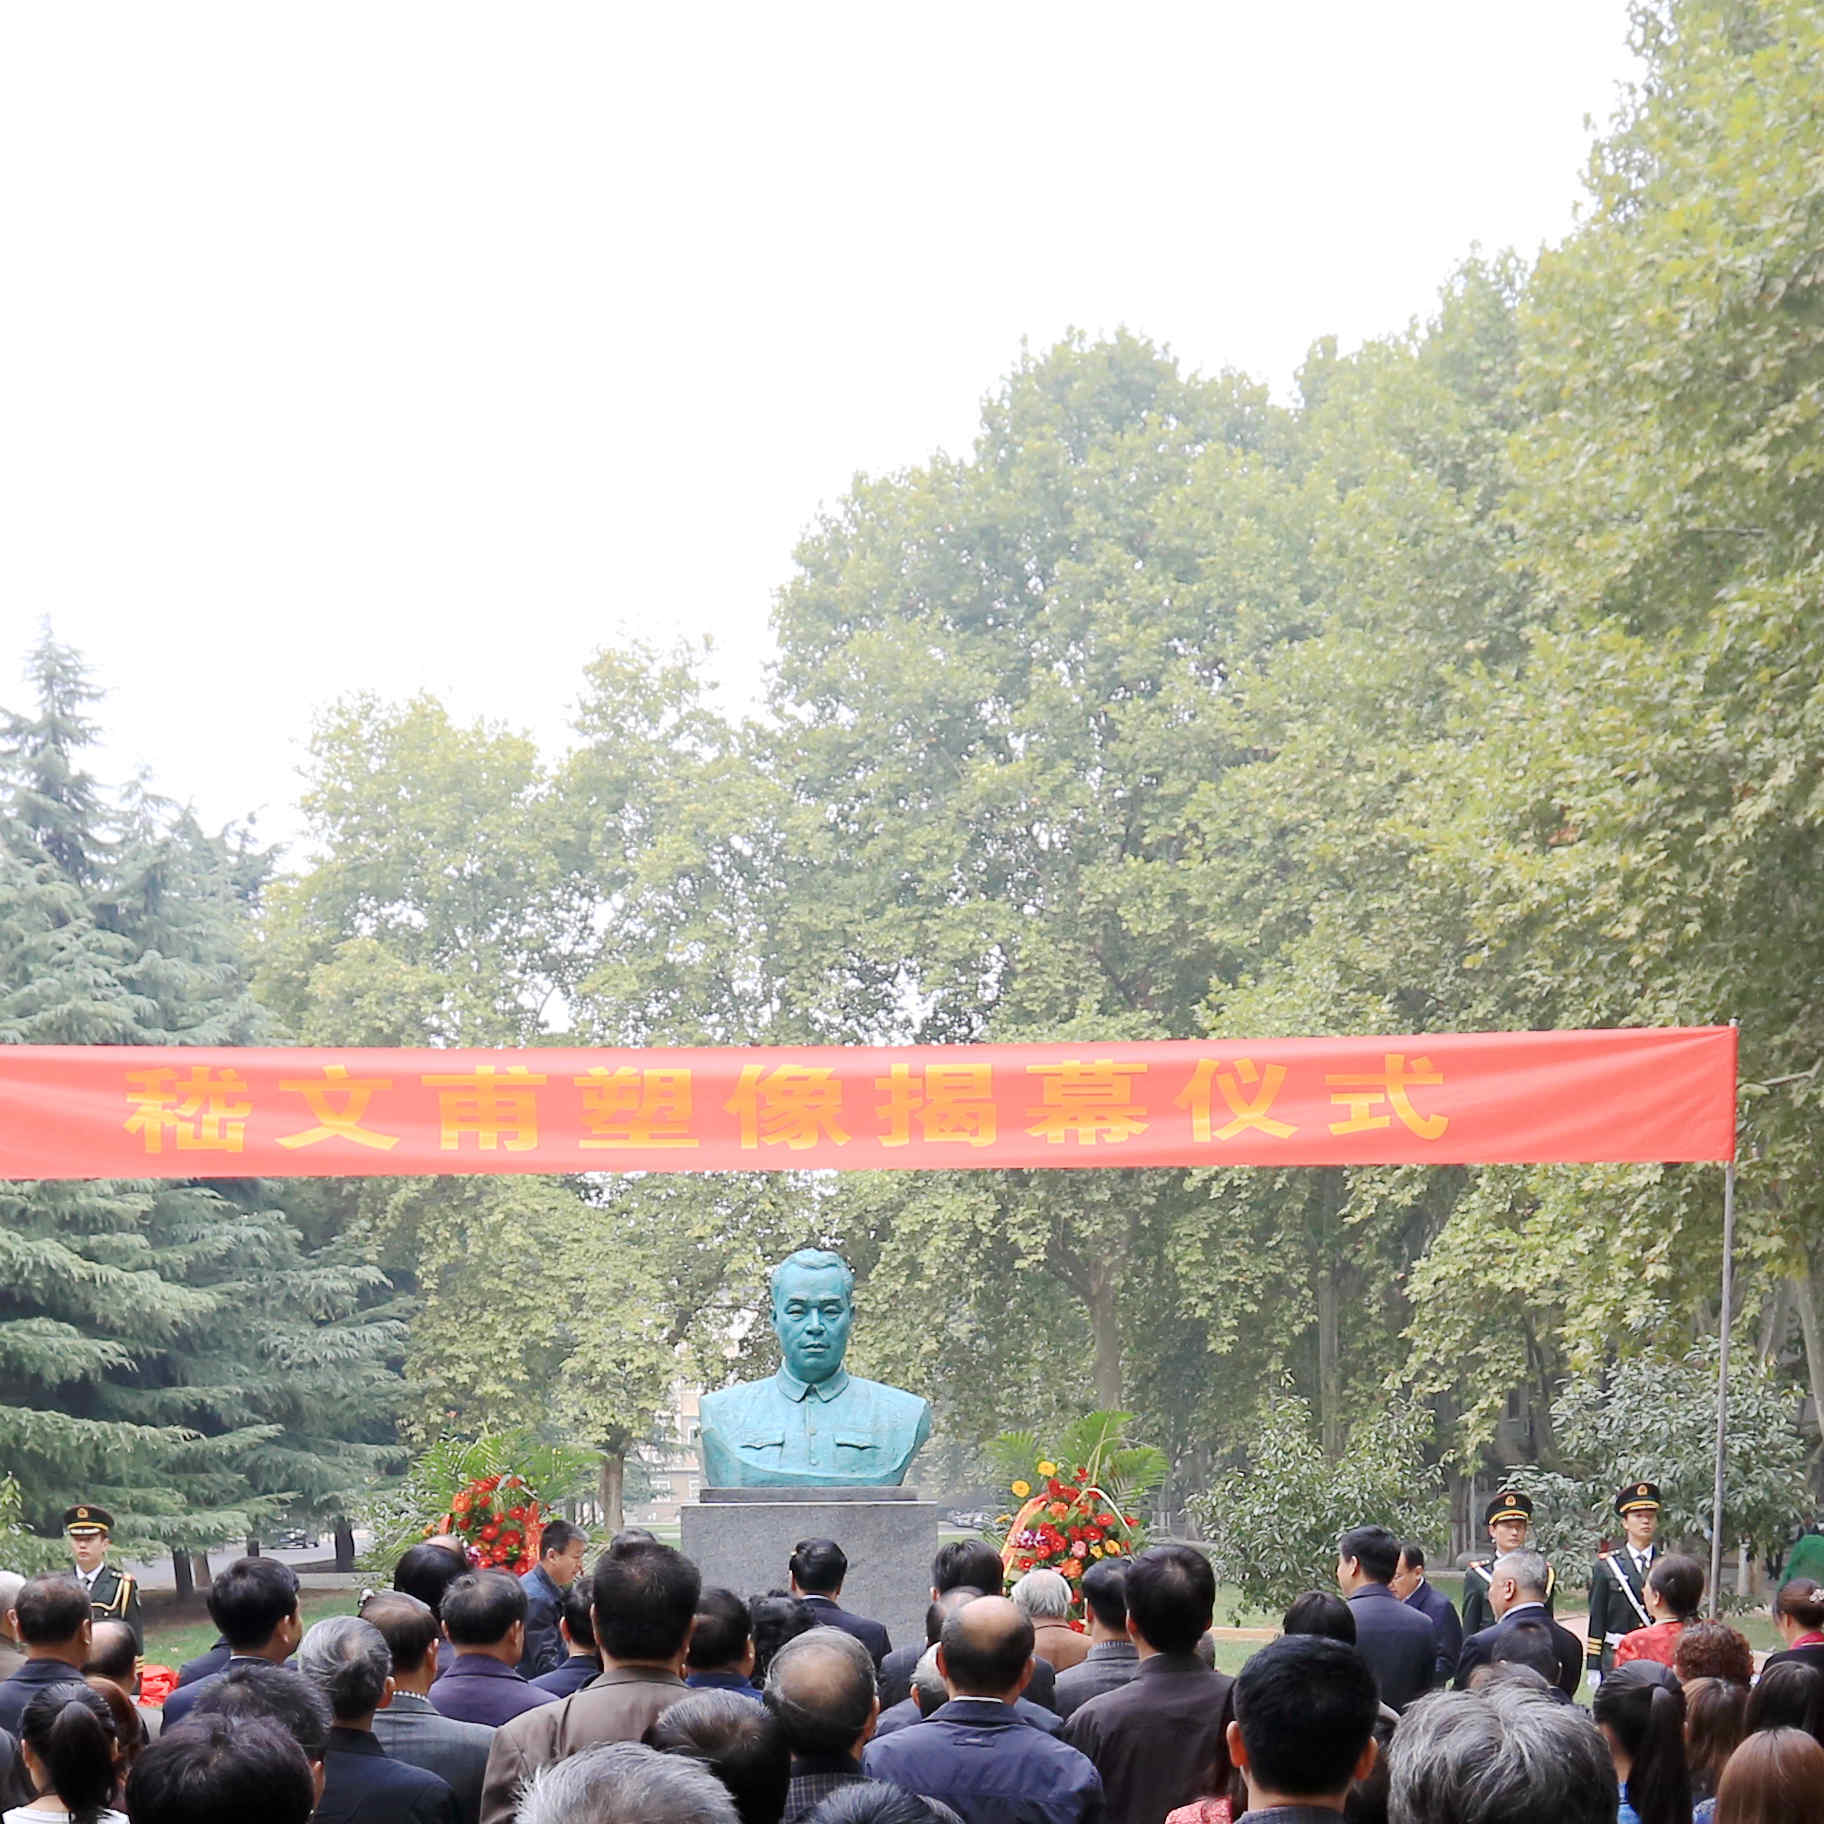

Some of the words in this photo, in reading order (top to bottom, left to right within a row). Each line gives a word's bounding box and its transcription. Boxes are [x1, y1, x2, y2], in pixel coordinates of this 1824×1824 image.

[123, 1053, 1450, 1154] 嵇文甫塑像揭幕仪式
